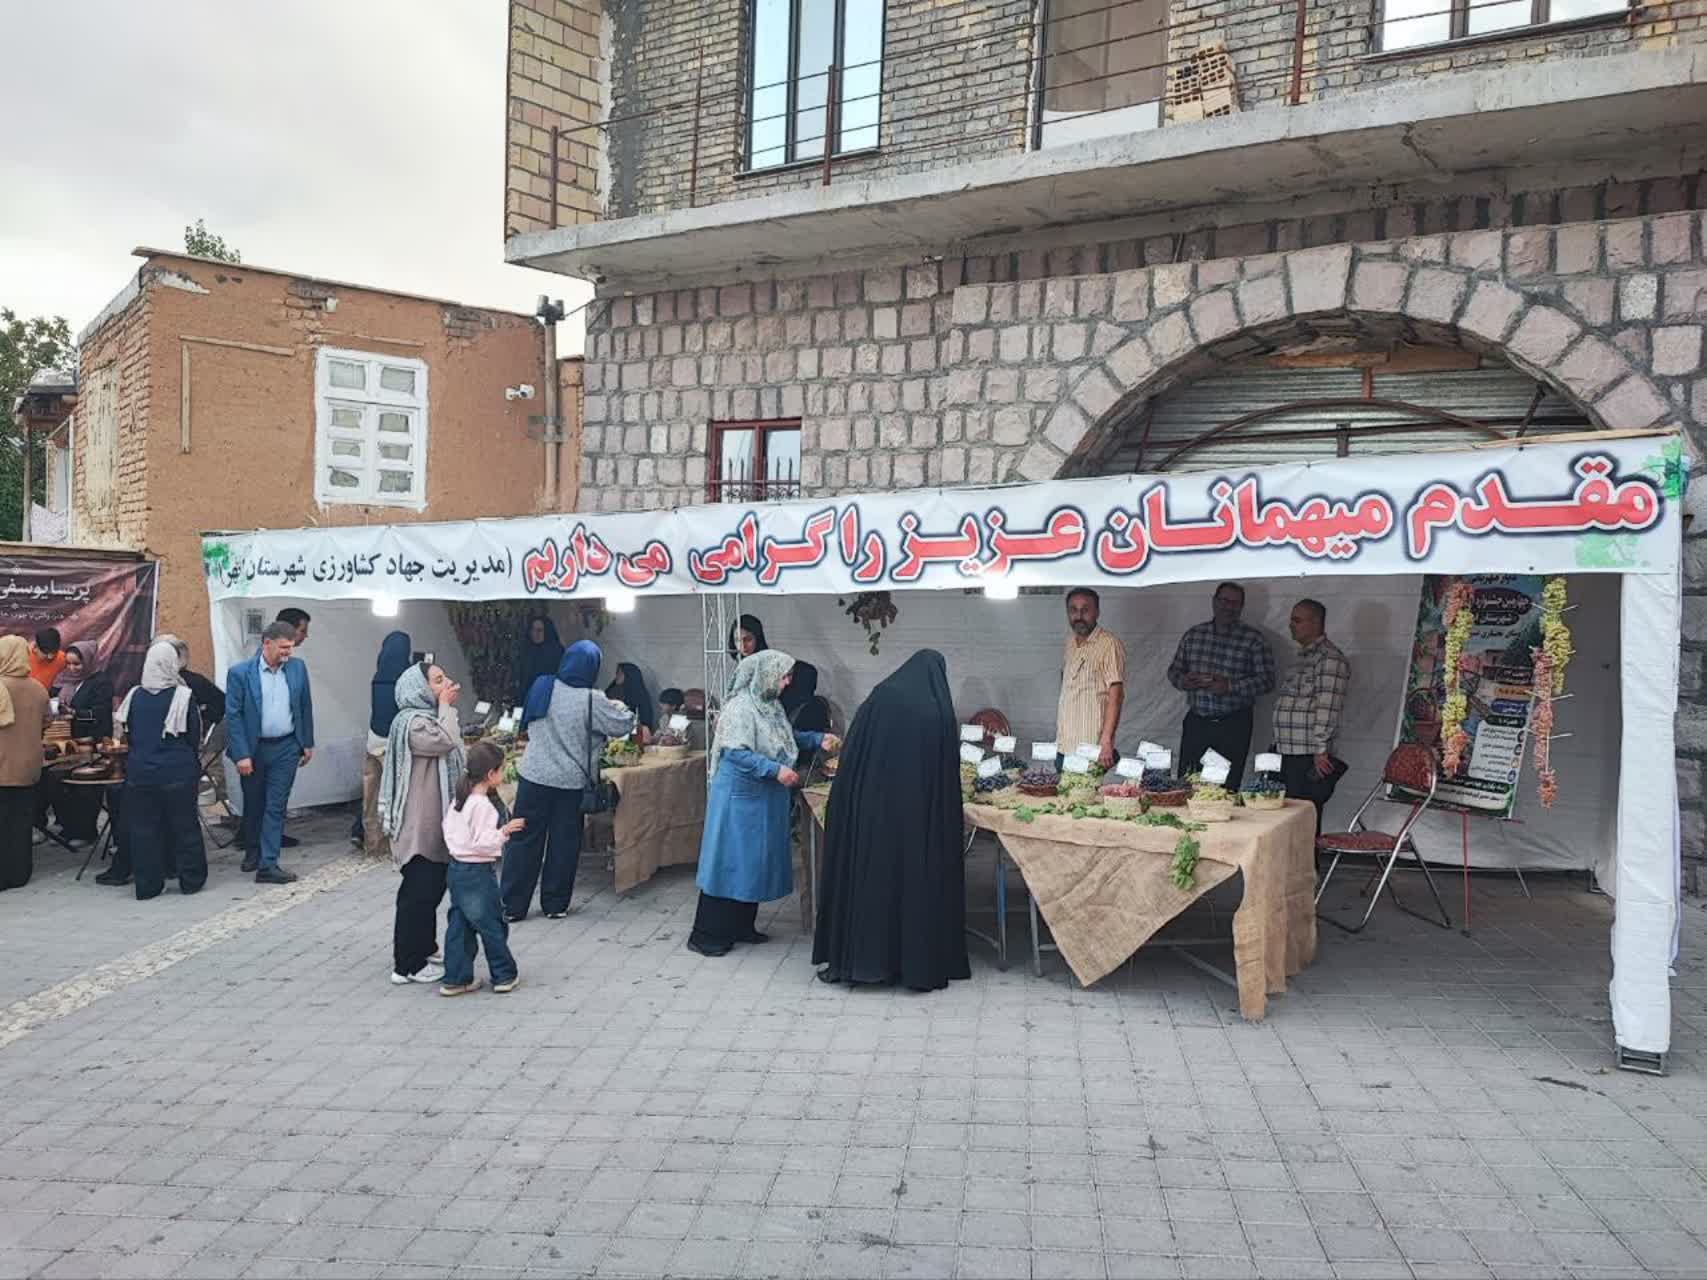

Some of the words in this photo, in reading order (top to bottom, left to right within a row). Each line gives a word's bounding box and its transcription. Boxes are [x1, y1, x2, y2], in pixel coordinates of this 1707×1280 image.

[1095, 473, 1396, 576] میهمانان
[1405, 452, 1666, 560] مقدم
[246, 554, 306, 585] شهرستان
[312, 552, 382, 583] کشاورزی
[386, 553, 424, 583] جهاد
[522, 522, 612, 593] داریم
[617, 539, 672, 587] می
[688, 507, 836, 585] گرامی
[839, 503, 888, 582] را
[889, 504, 1088, 582] عزیز
[51, 578, 91, 603] پریسا
